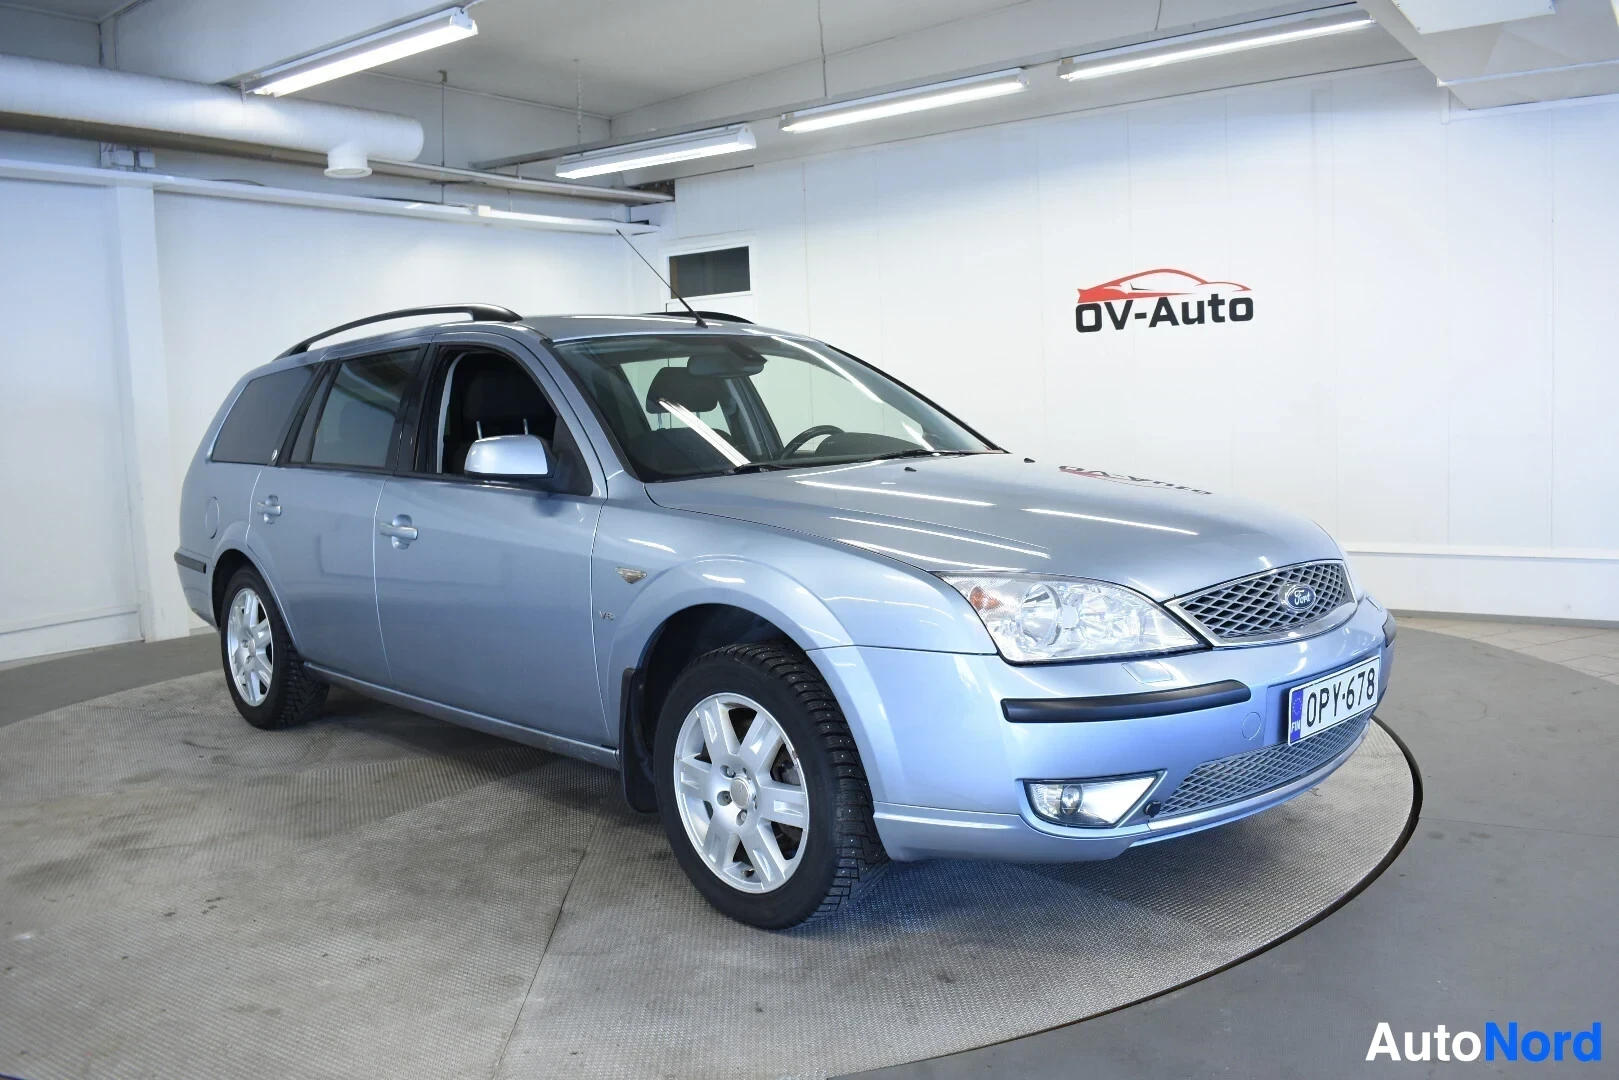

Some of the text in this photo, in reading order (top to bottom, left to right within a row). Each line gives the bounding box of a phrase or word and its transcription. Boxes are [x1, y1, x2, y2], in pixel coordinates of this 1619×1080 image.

[1075, 293, 1254, 333] OV-Auto
[1294, 589, 1311, 606] Ford
[1306, 667, 1376, 728] OPY-678
[1291, 719, 1301, 731] FIN
